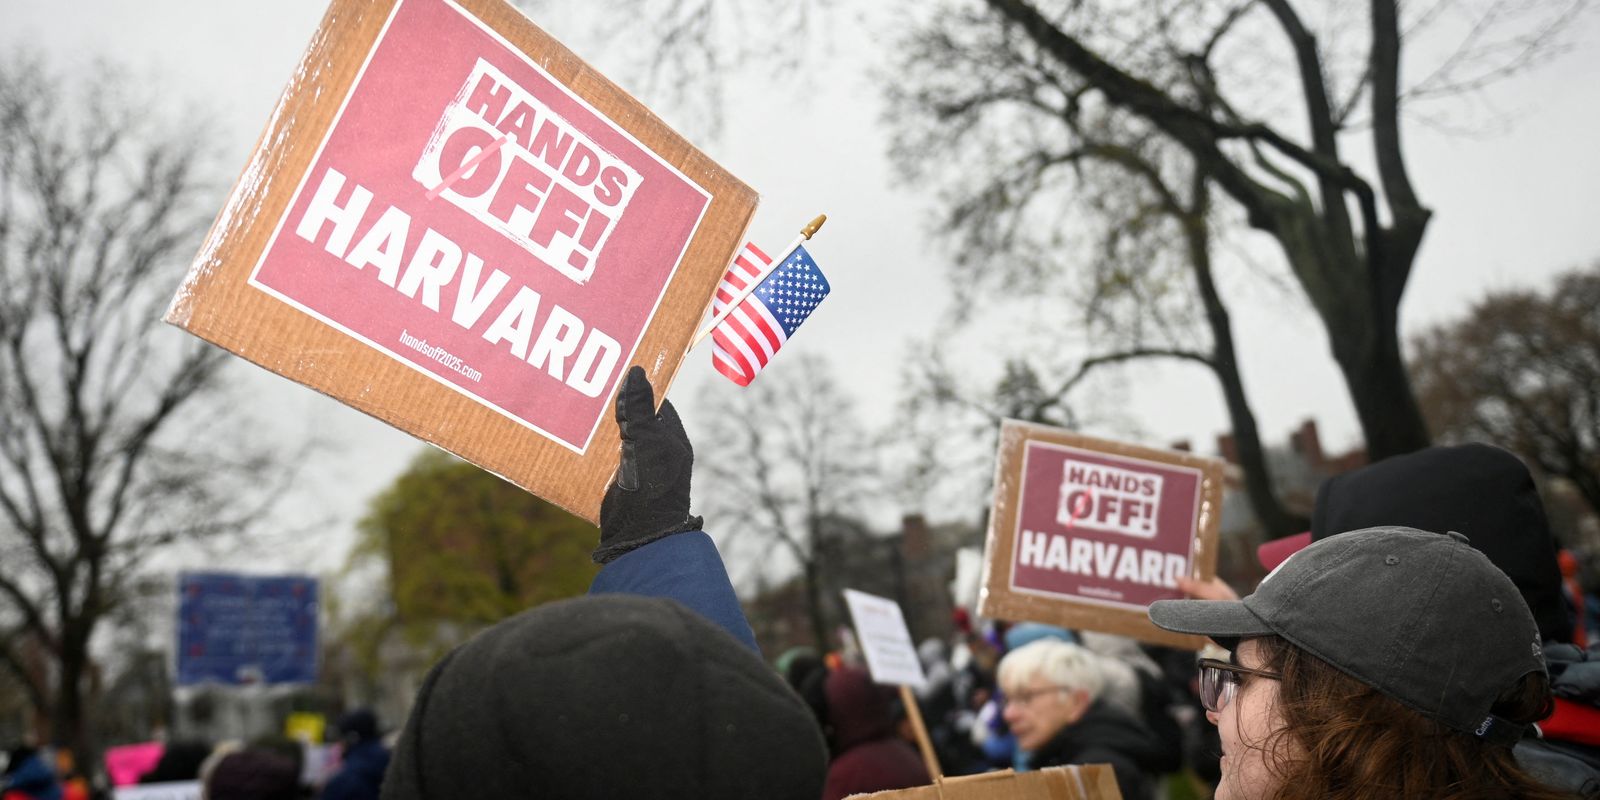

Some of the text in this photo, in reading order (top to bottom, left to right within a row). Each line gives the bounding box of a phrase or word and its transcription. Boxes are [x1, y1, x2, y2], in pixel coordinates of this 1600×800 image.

[465, 72, 628, 207] HANDS
[436, 125, 613, 268] OFF!
[295, 167, 622, 398] HARVARD
[399, 328, 482, 383] handsoff2025.com
[1068, 466, 1156, 496] HANDS
[1066, 490, 1154, 532] OFF!
[1019, 529, 1187, 588] HARVARD
